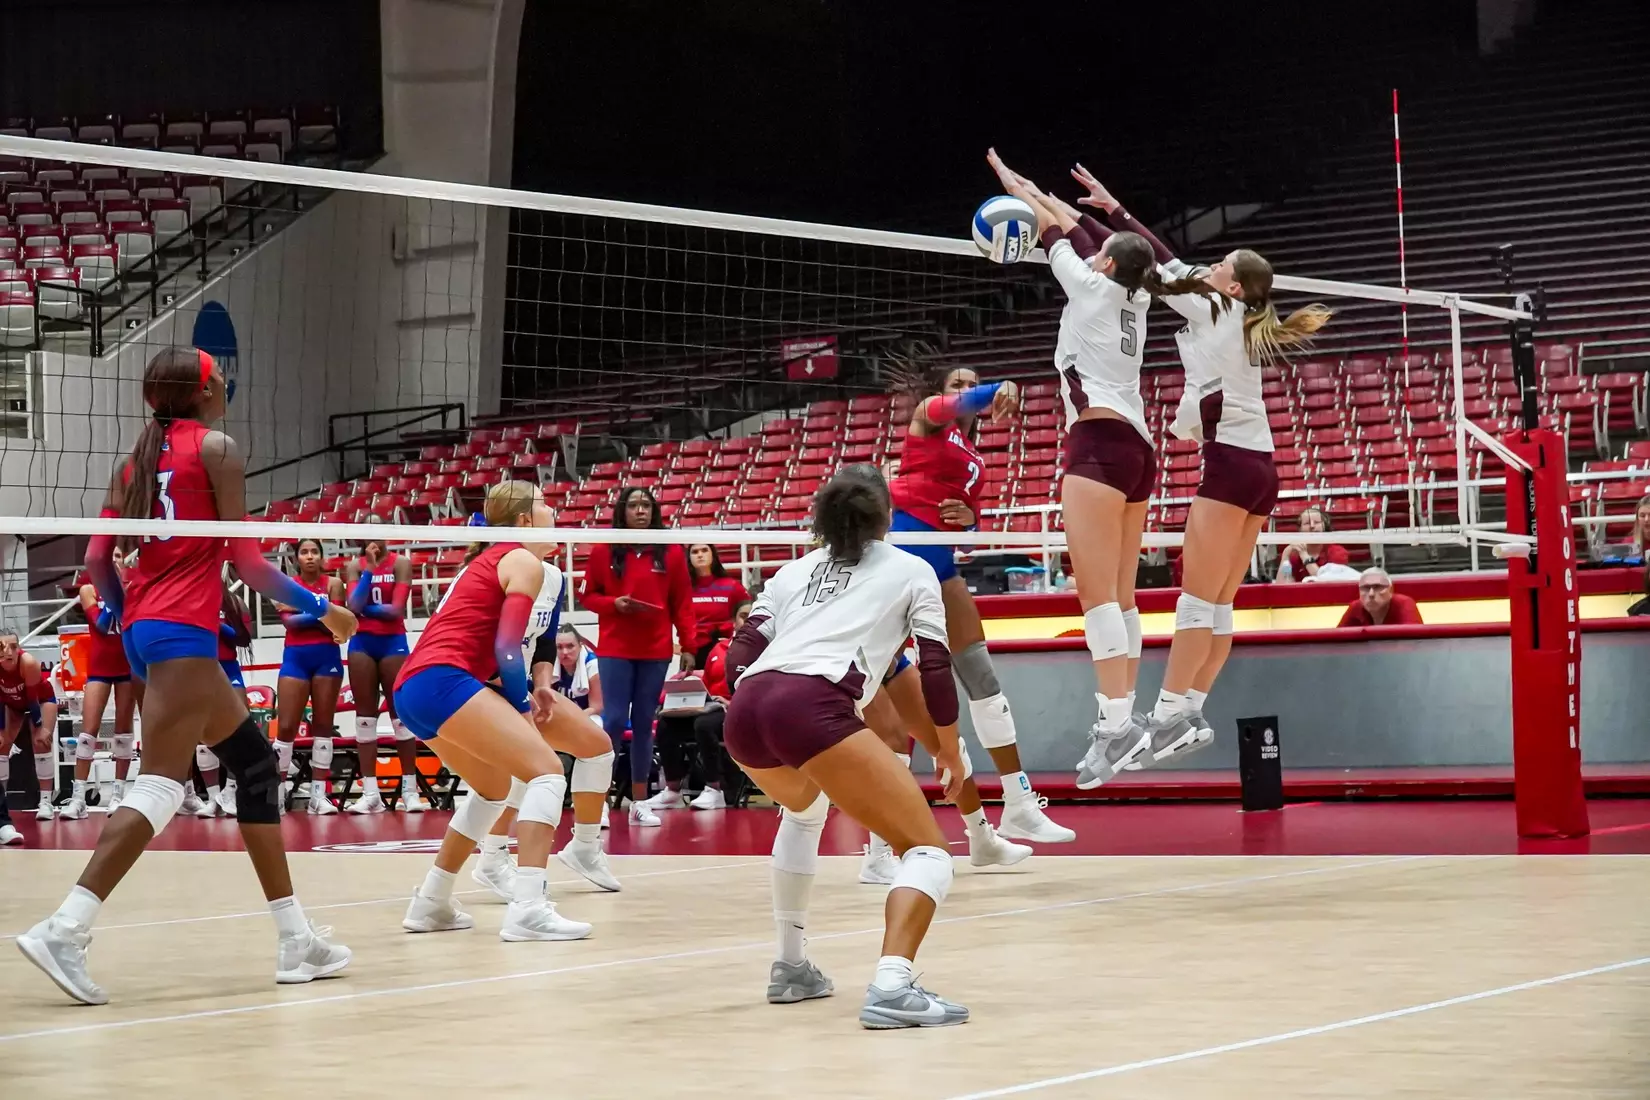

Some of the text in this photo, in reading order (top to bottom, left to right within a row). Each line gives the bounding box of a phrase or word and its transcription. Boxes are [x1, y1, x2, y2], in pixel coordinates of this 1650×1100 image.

[129, 320, 137, 329] 4
[1120, 308, 1137, 357] 5
[16, 401, 21, 410] 1
[801, 560, 860, 607] 15
[1561, 504, 1576, 749] TOGETHER
[61, 643, 70, 661] G
[298, 725, 307, 737] G
[1261, 745, 1278, 753] VIDEO
